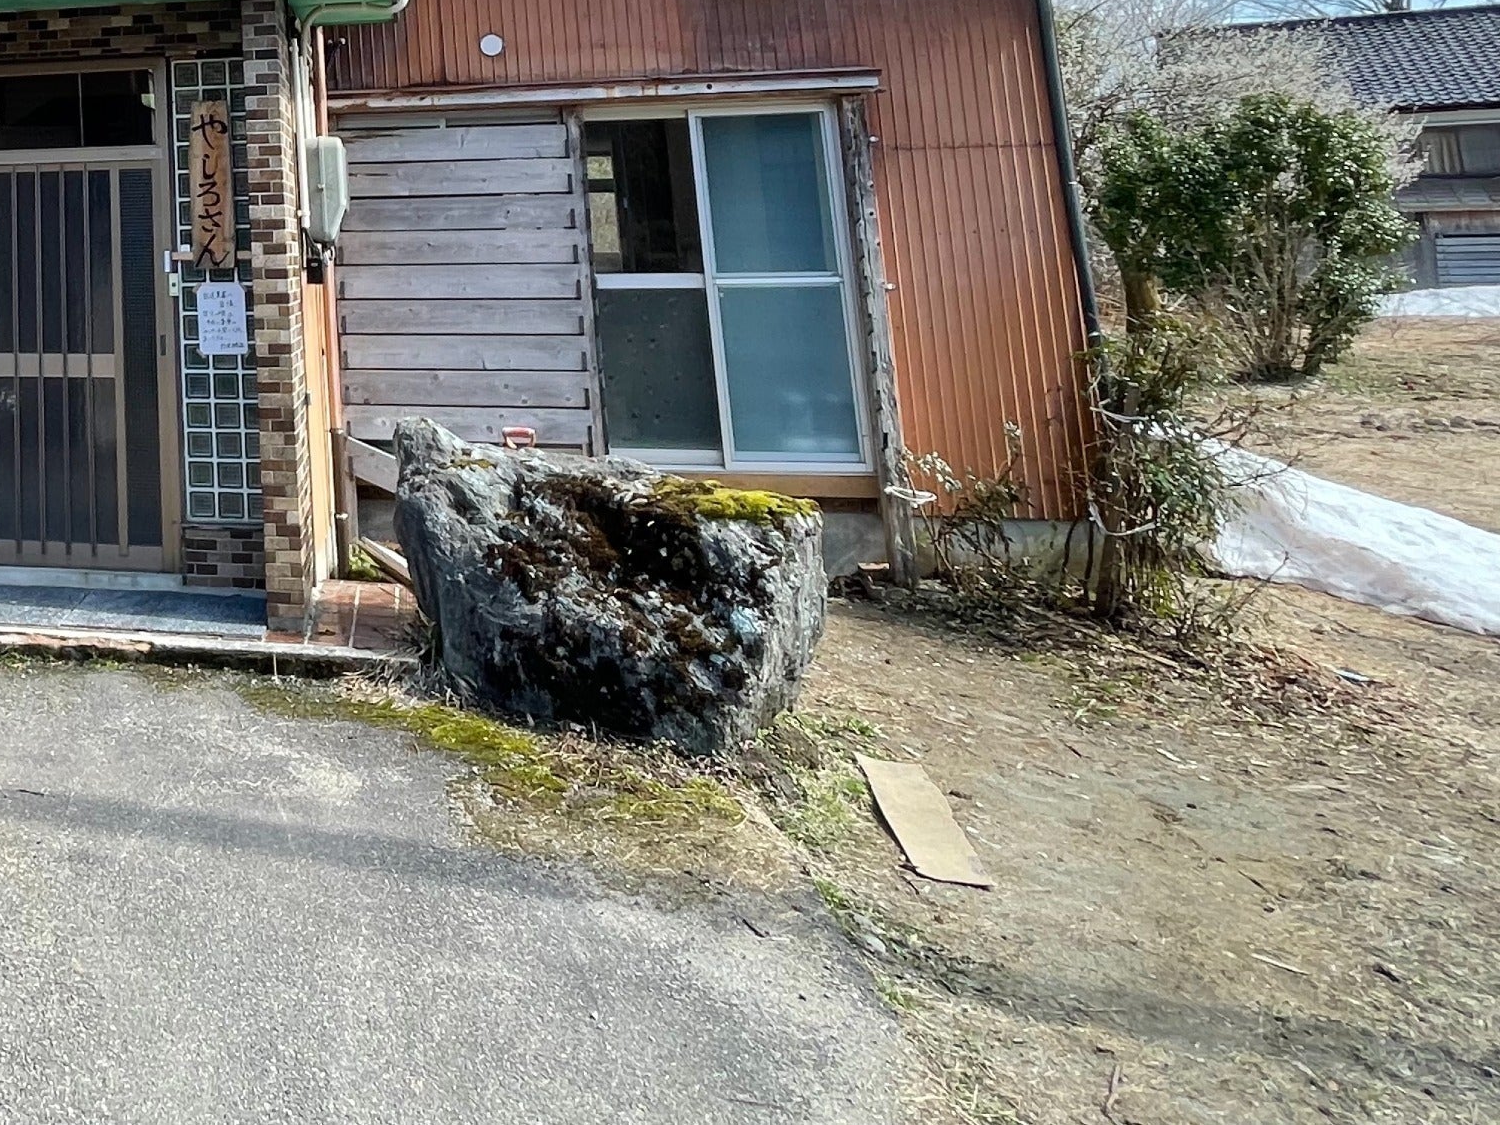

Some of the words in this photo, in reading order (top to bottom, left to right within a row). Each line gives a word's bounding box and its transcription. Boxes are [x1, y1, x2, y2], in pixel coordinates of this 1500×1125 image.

[192, 114, 229, 267] やしろさん
